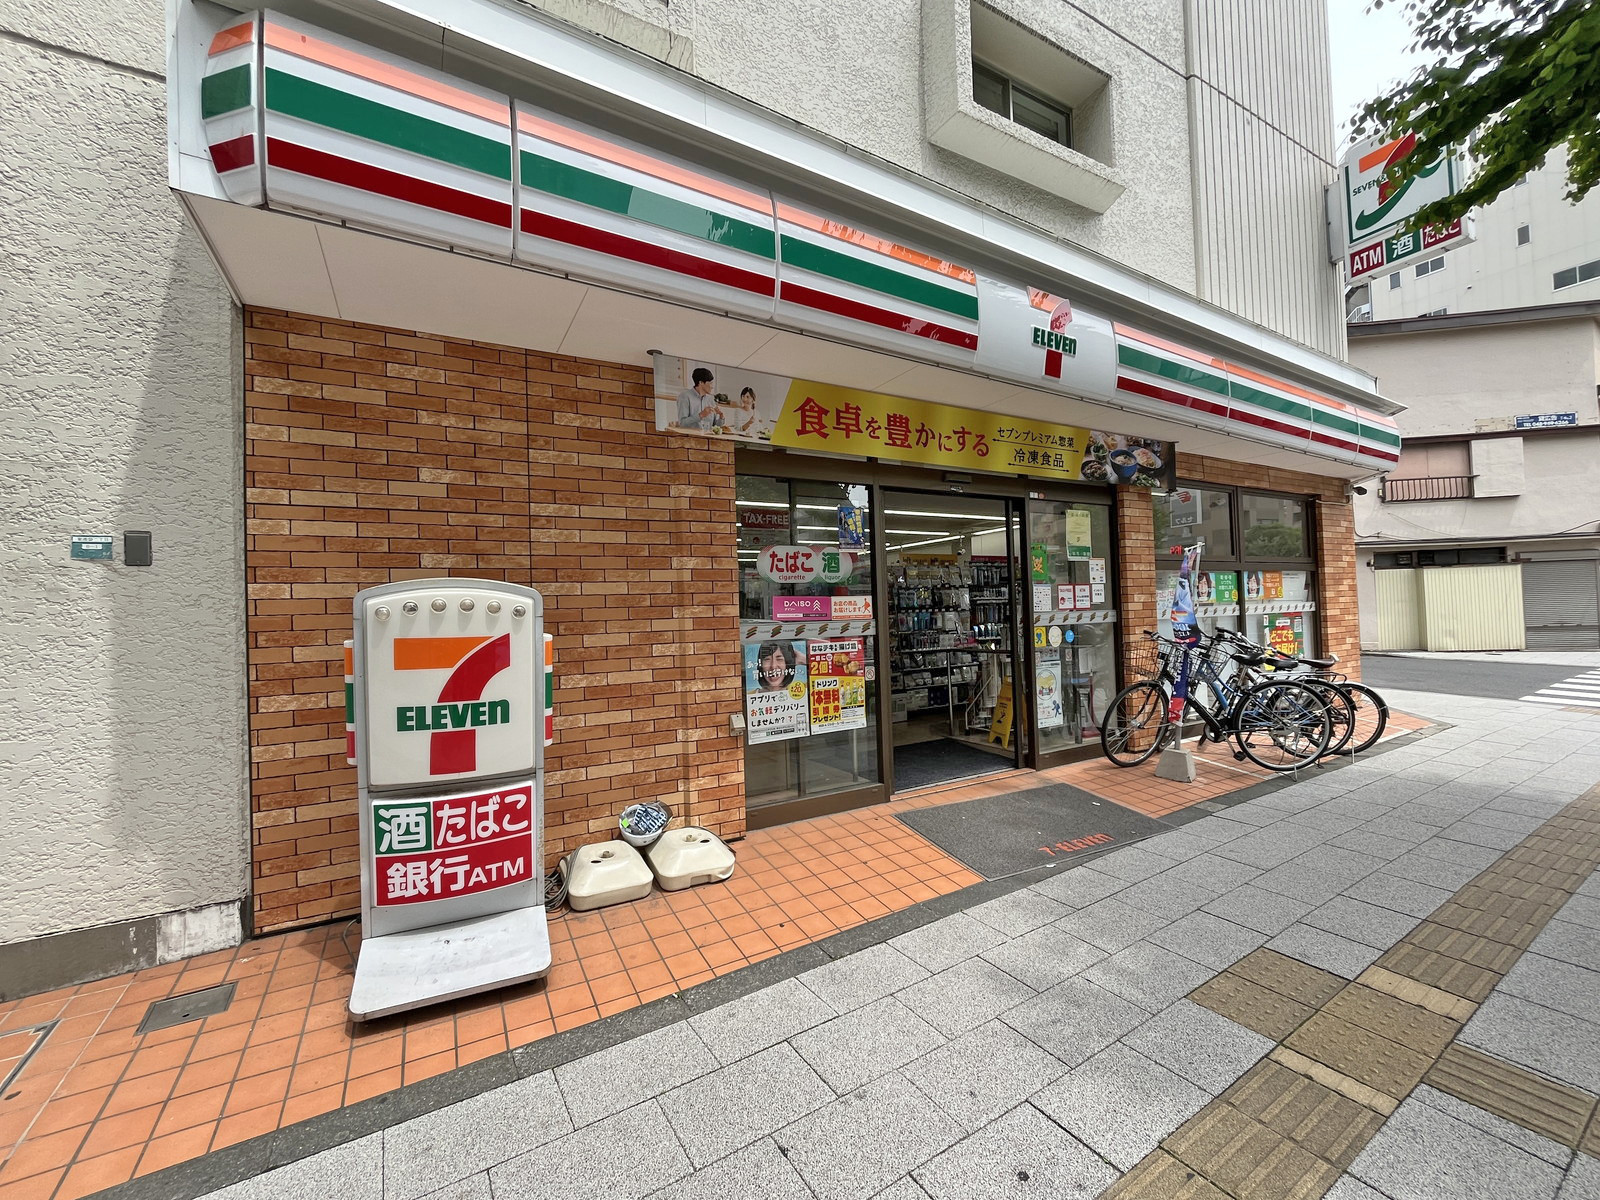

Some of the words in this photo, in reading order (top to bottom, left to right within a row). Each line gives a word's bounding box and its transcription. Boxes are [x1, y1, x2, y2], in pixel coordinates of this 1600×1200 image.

[1391, 232, 1414, 259] 酒
[1352, 246, 1383, 274] ATM
[792, 396, 991, 458] 食卓を豊かにする
[996, 426, 1075, 449] セブンプレミアム惣菜
[1013, 448, 1065, 468] 冷凍食品
[743, 512, 789, 525] TAX-FREE
[769, 550, 814, 573] たばこ
[821, 552, 840, 574] 酒
[1269, 628, 1294, 643] どこでも
[816, 679, 838, 689] ドリンク
[393, 632, 511, 776] 7
[750, 703, 806, 717] お気軽デリバリー
[378, 806, 428, 853] 酒
[436, 793, 529, 847] たばこ
